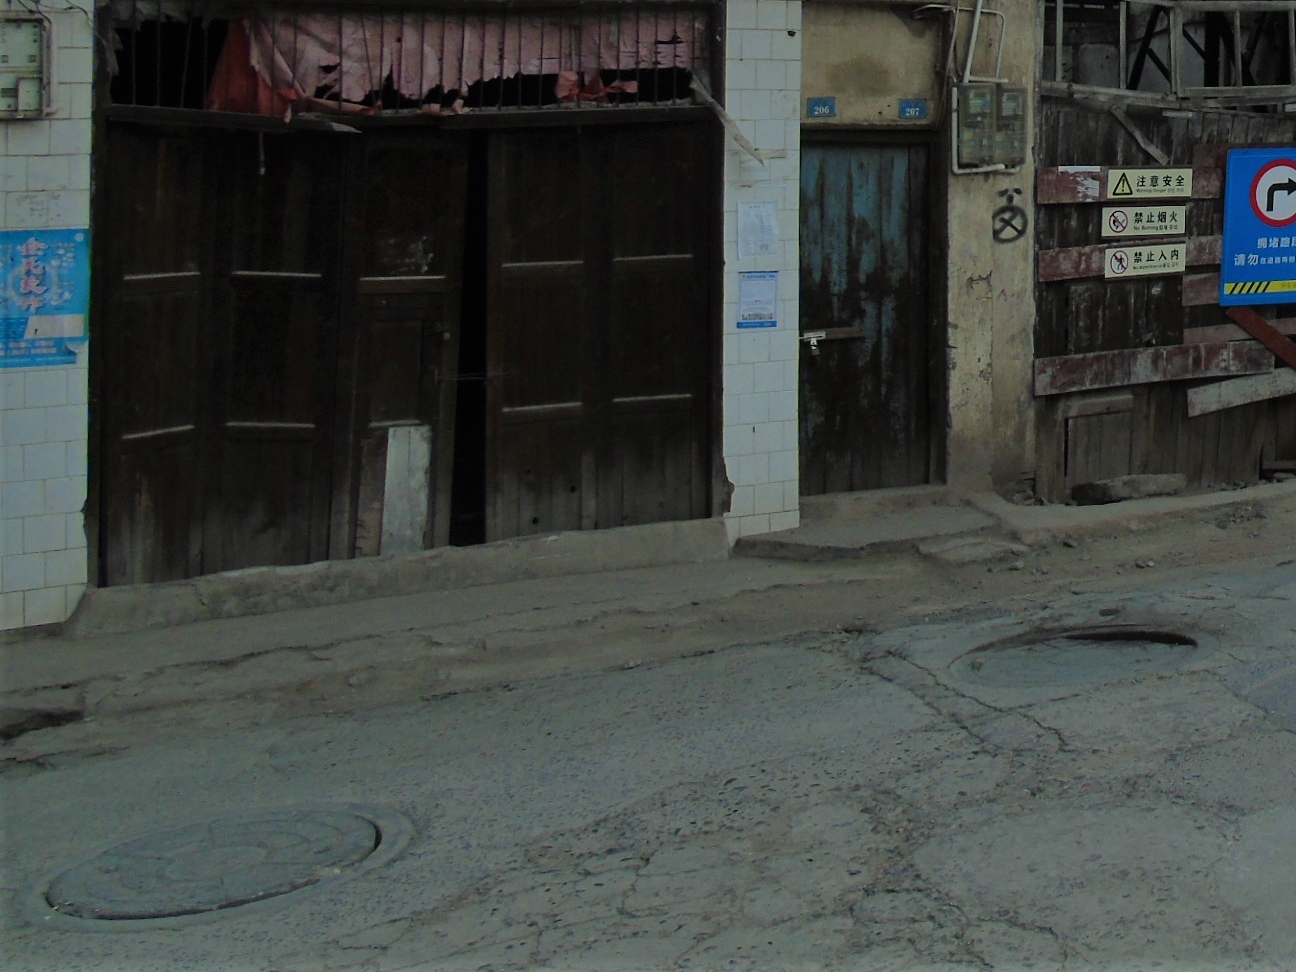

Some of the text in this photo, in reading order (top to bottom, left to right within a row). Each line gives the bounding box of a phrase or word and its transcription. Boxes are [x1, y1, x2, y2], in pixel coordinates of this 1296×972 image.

[814, 106, 830, 115] 206
[905, 108, 920, 116] 207
[1136, 175, 1185, 187] 注意安全
[1134, 211, 1178, 224] 禁止烟火
[1133, 249, 1179, 263] 禁止入内
